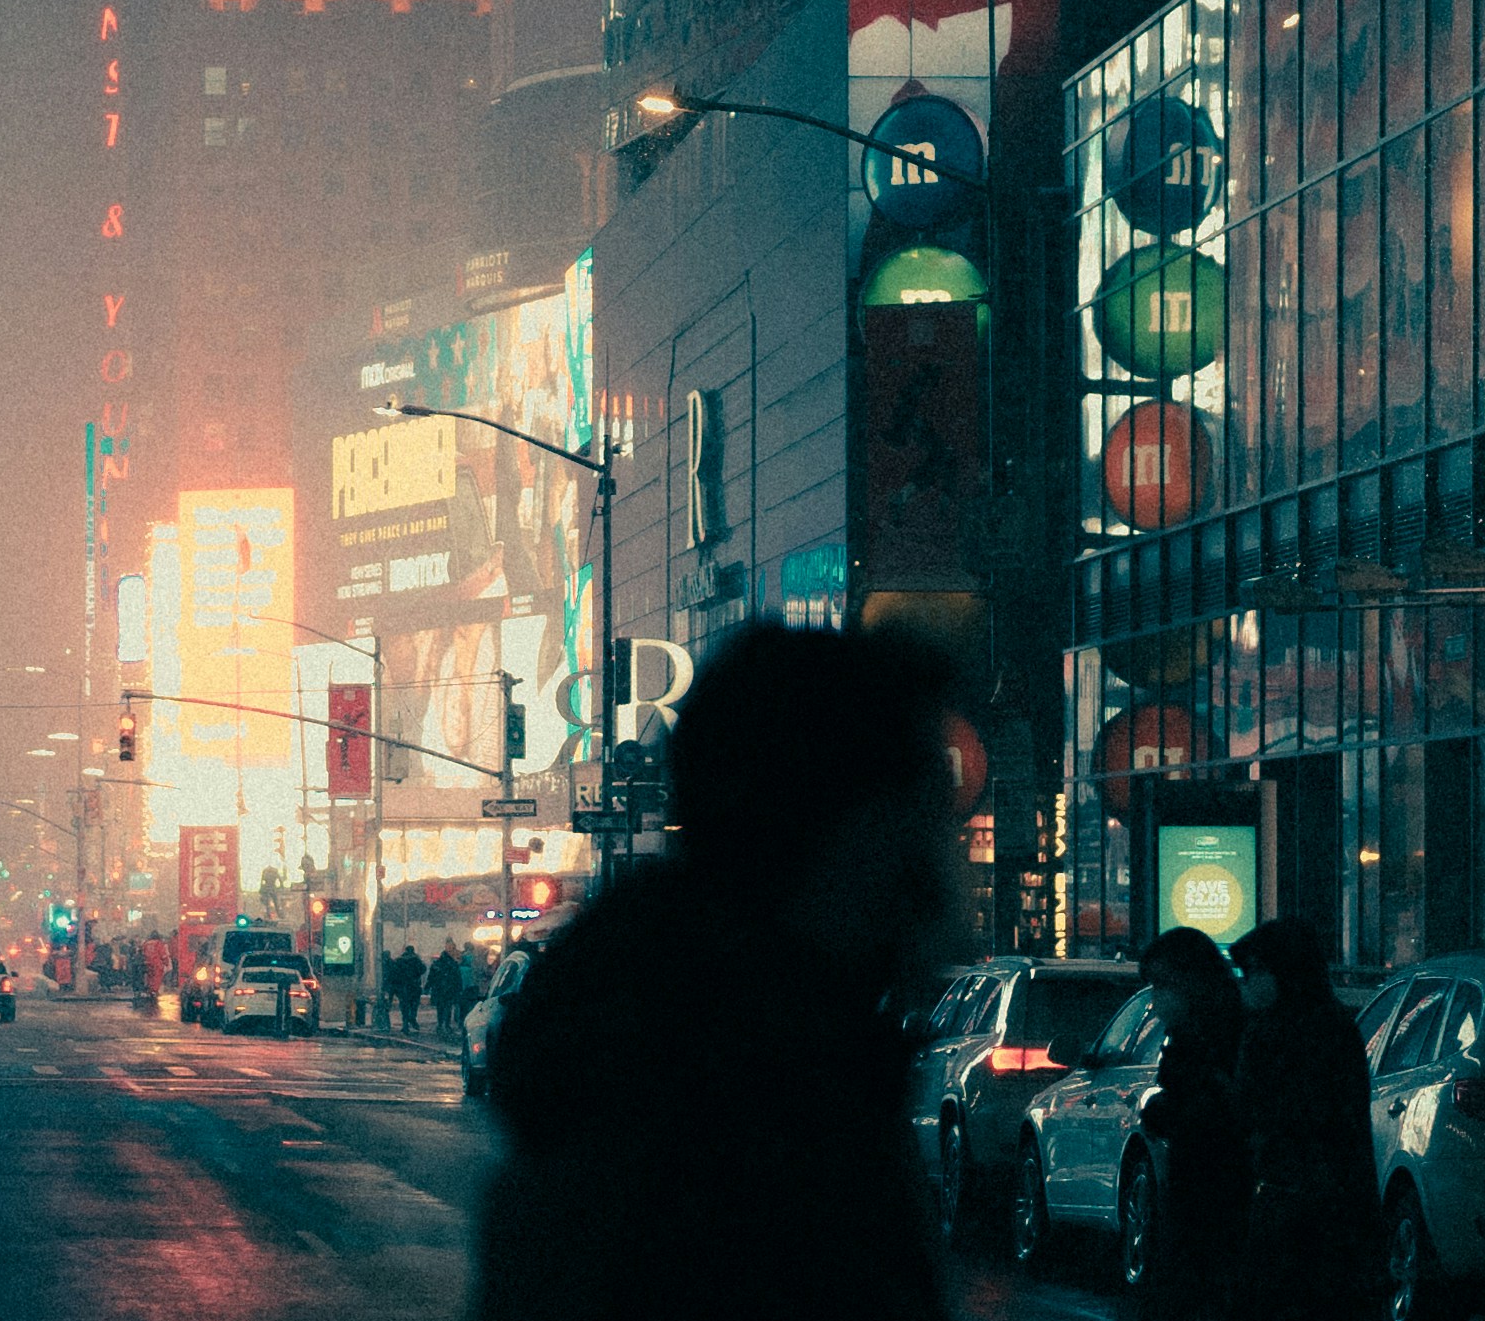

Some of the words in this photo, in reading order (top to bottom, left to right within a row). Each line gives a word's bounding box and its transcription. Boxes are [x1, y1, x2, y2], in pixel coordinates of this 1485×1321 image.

[890, 142, 939, 186] m
[102, 203, 124, 239] &
[191, 831, 227, 899] tkts
[1185, 880, 1229, 894] SAVE
